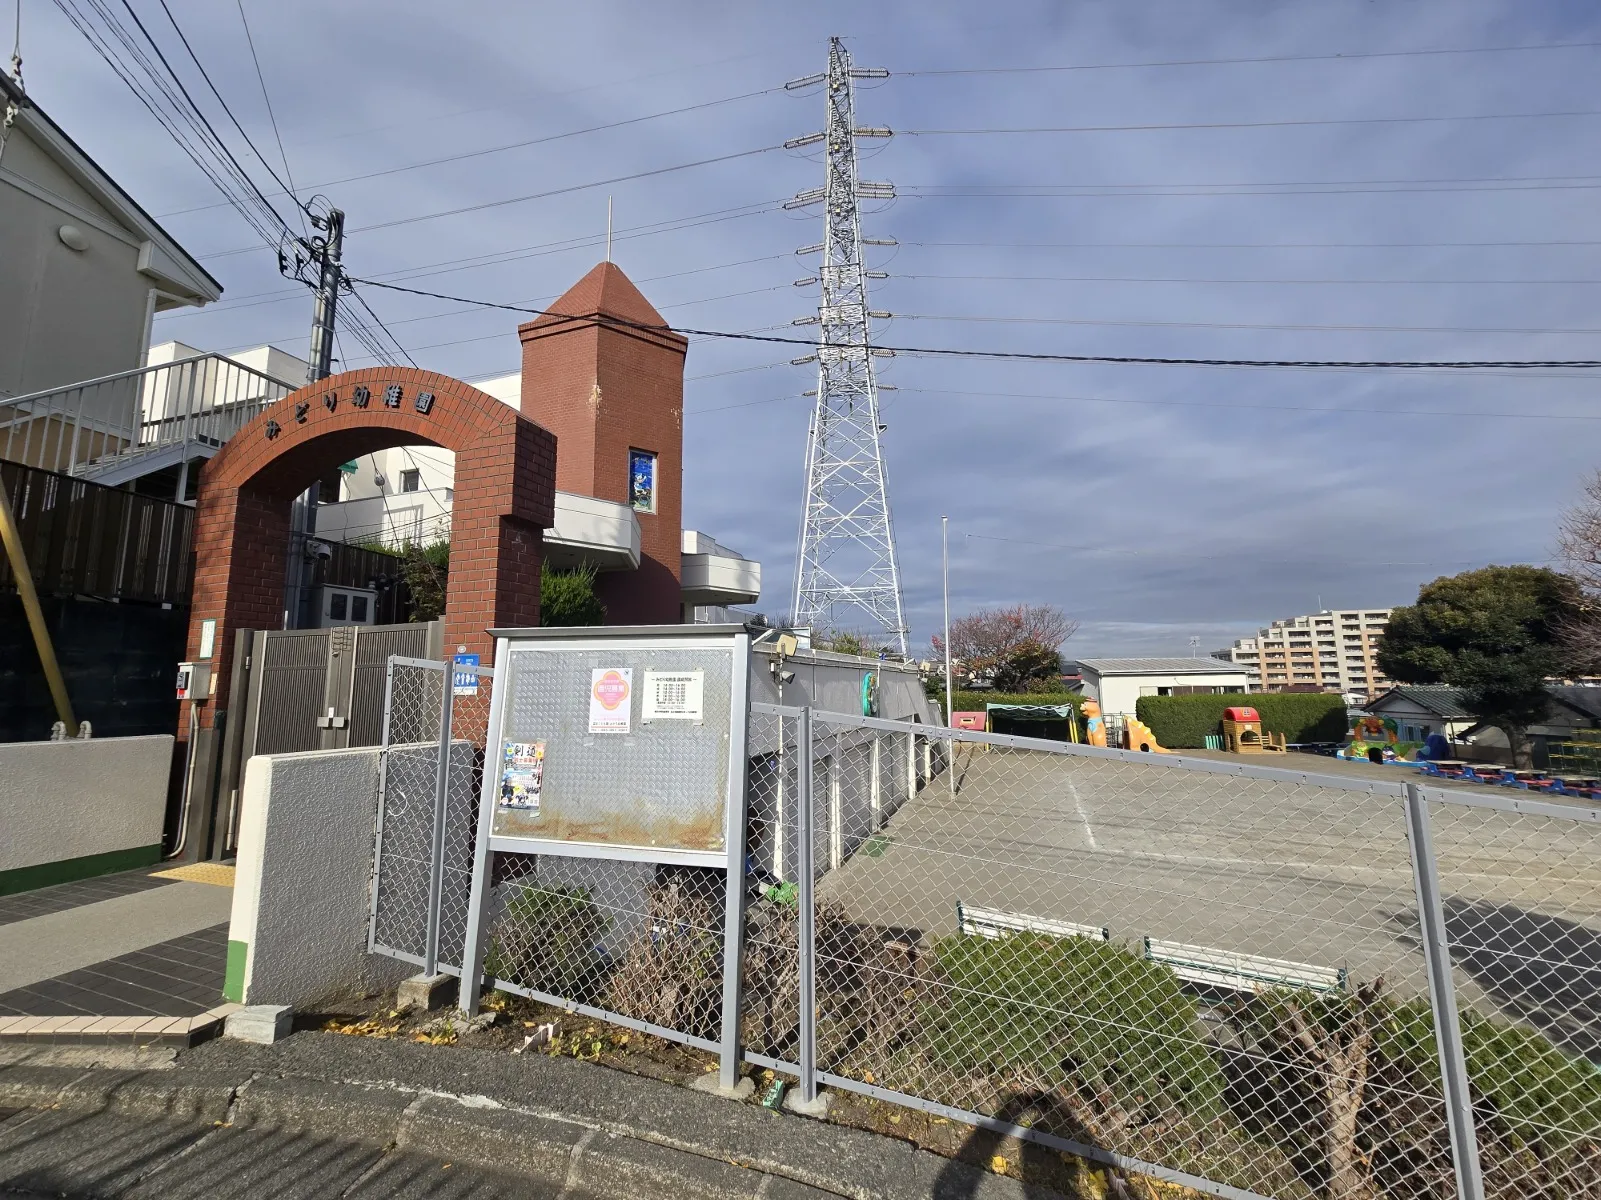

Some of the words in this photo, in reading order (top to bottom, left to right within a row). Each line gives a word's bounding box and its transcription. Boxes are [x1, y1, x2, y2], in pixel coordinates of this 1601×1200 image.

[264, 384, 436, 441] みどり幼稚園
[513, 744, 536, 758] 剣道
